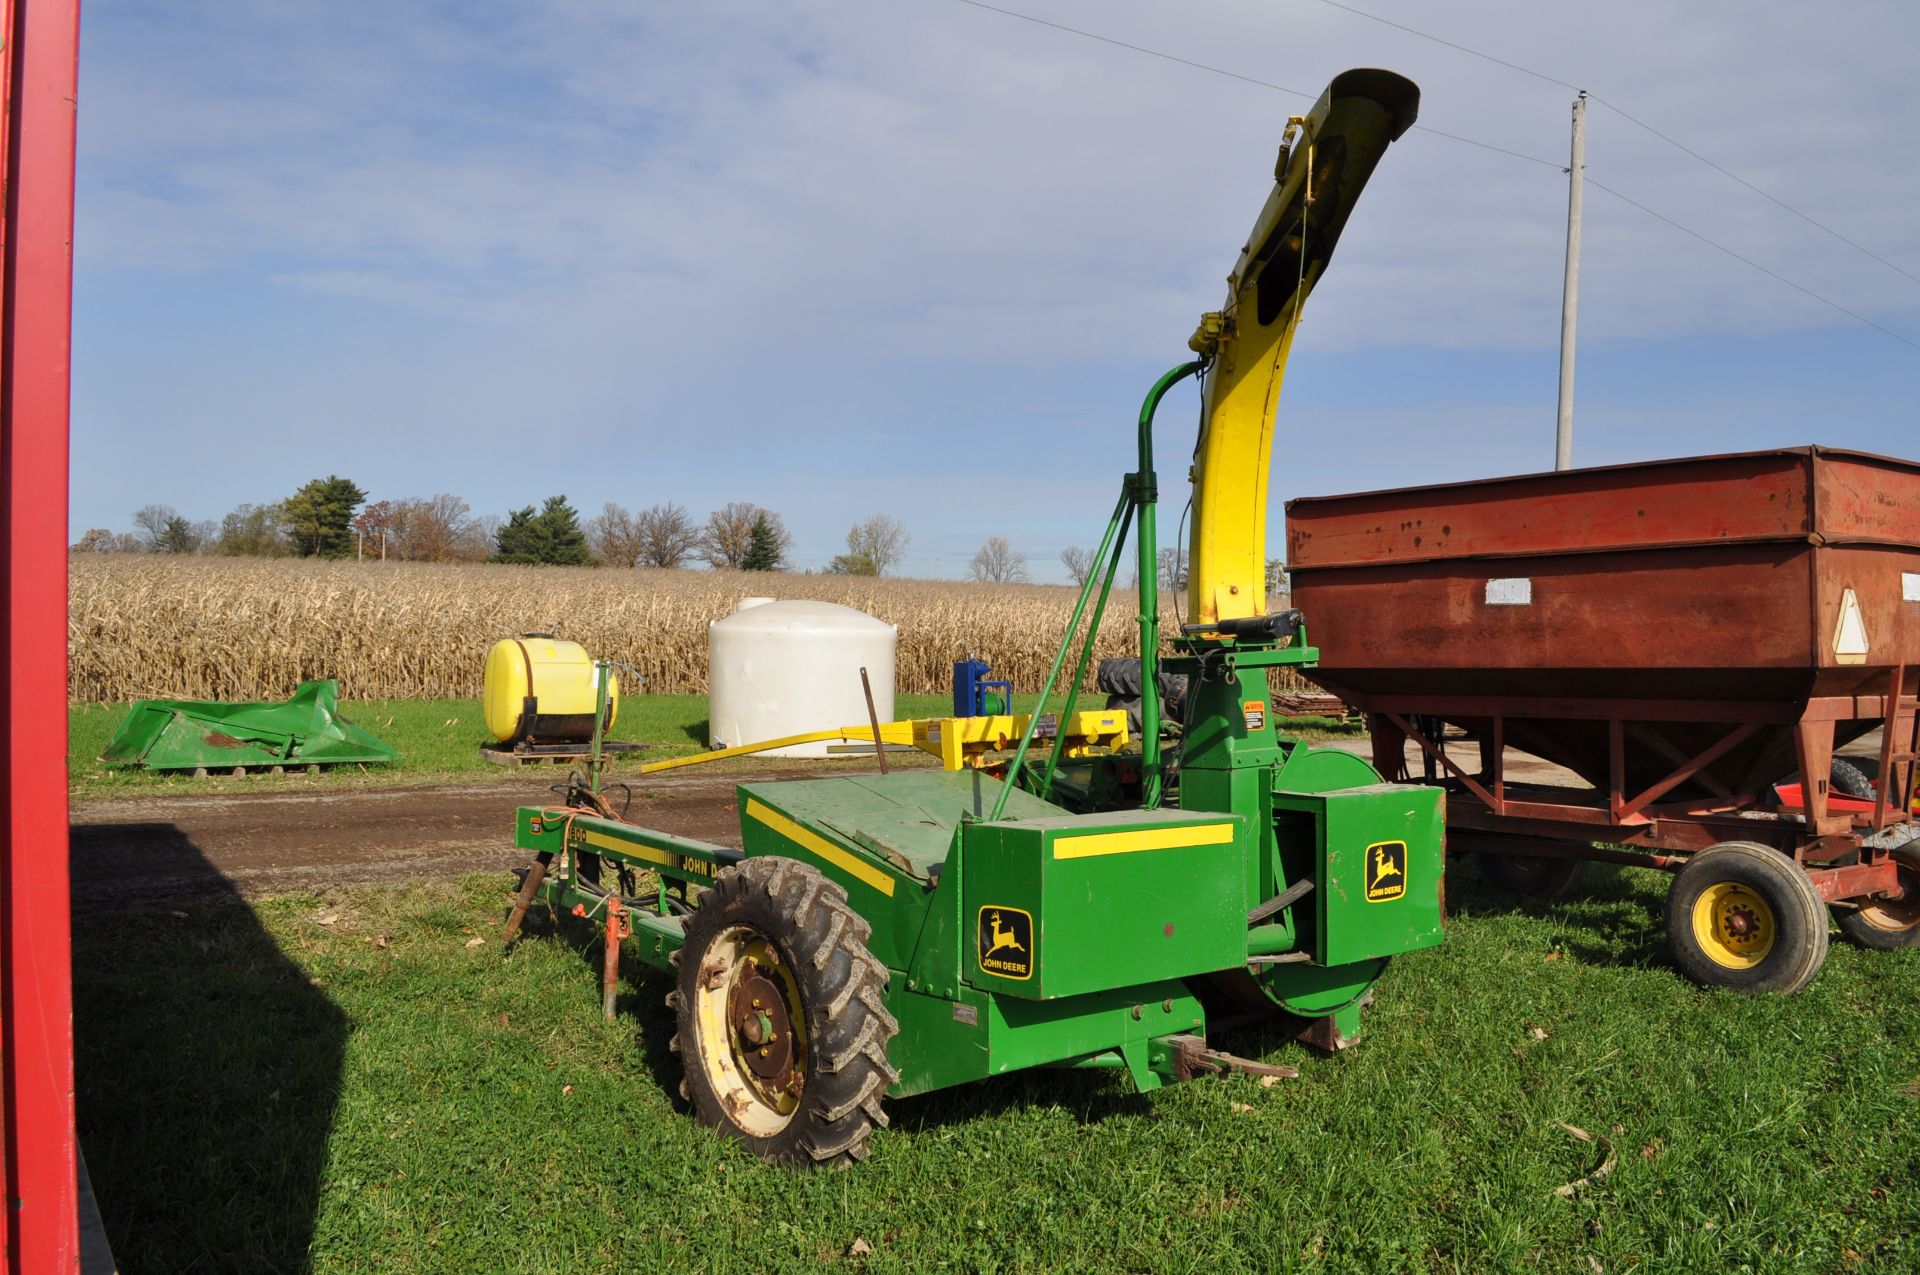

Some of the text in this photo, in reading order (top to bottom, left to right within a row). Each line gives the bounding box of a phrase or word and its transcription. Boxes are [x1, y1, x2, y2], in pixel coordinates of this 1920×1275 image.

[683, 856, 708, 877] JOHN
[1369, 885, 1402, 898] JOHN DEERE
[983, 959, 1026, 974] JOHN DEERE
